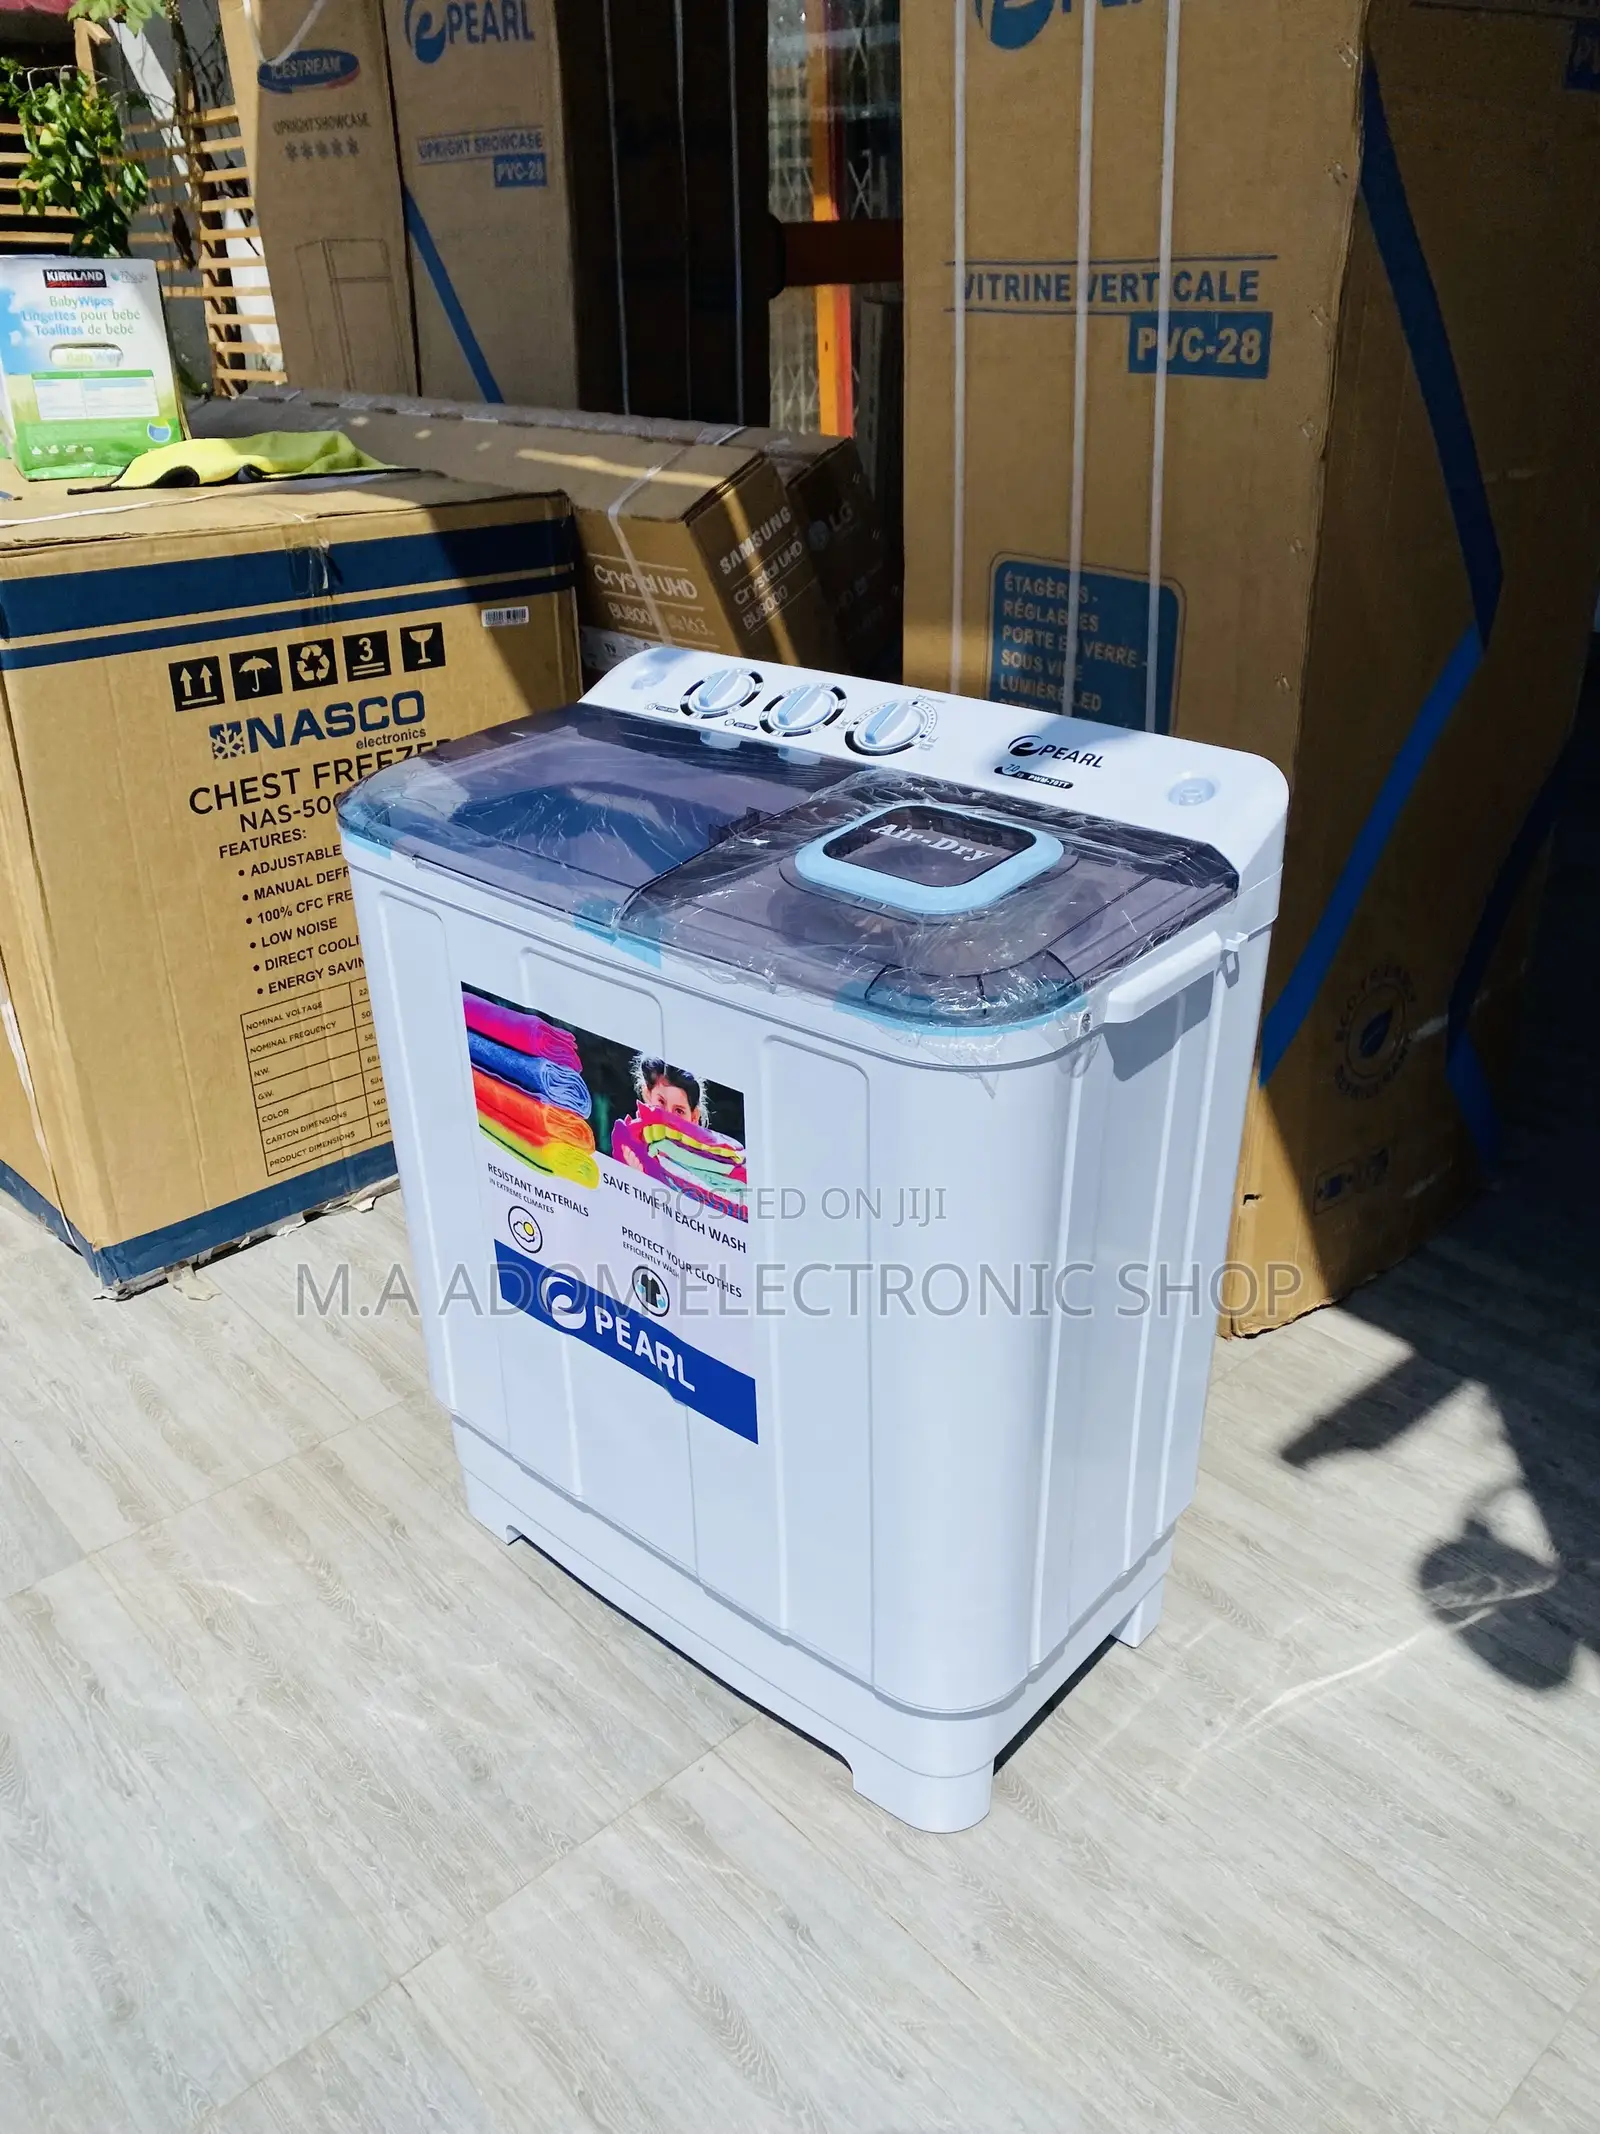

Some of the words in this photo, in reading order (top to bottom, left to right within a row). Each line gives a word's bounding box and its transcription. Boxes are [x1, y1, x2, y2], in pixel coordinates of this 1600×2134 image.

[447, 0, 535, 45] PEARL
[420, 137, 470, 159] UPRIGHT
[474, 131, 543, 154] SHOWCASE
[46, 270, 104, 282] KIRKLAND
[1088, 270, 1260, 303] VERTCALE
[22, 310, 77, 324] Lingettes
[81, 312, 108, 324] pour
[34, 324, 84, 336] Toallitas
[87, 324, 101, 335] de
[1136, 326, 1262, 365] PVC-28
[720, 506, 792, 575] SAMSUNG
[778, 540, 803, 568] UHD
[594, 564, 660, 594] Crysal
[657, 575, 698, 600] UHD
[1003, 569, 1089, 605] ÉTAGÈRS
[1003, 598, 1100, 634] RÉGLABES
[1002, 625, 1054, 650] PORTE
[1083, 641, 1137, 669] VERRE
[1000, 649, 1044, 674] SOUS
[1048, 660, 1083, 682] VIE
[1073, 691, 1102, 712] ED
[246, 689, 426, 754] NASCO
[356, 727, 427, 750] electronics
[1038, 744, 1104, 768] PEARL
[189, 768, 301, 815] CHEST
[313, 738, 452, 789] FREE
[219, 828, 307, 859] FEATURES:
[870, 823, 994, 862] Air-Dry
[251, 844, 343, 877] ADJUSTABLE
[254, 877, 313, 901] MANUAL
[257, 906, 293, 924] 100%
[296, 897, 324, 913] CFC
[261, 928, 293, 948] LOW
[296, 917, 338, 938] NOISE
[264, 947, 314, 972] DIRECT
[268, 968, 324, 995] ENERGY
[246, 1015, 284, 1031] NOMINAL
[285, 1001, 323, 1018] VOLTAGE
[249, 1038, 288, 1055] NOMINAL
[289, 1020, 337, 1042] FREQUENCY
[261, 1108, 290, 1123] COLOR
[265, 1128, 299, 1145] CARTON
[300, 1110, 349, 1133] DIMENSIONS
[269, 1148, 308, 1168] PRODUCT
[308, 1130, 356, 1153] DIMENSIONS
[487, 1162, 533, 1193] RESISTANT
[534, 1186, 589, 1217] MATERIALS
[496, 1181, 522, 1200] EXTREME
[523, 1195, 555, 1214] CLIMATES
[602, 1173, 630, 1195] SAVE
[632, 1186, 660, 1210] TIME
[662, 1202, 673, 1218] IN
[675, 1210, 706, 1235] EACH
[708, 1226, 747, 1253] WASH
[621, 1226, 665, 1255] PROTECT
[666, 1249, 692, 1274] YOUR
[695, 1268, 742, 1298] CLOTHES
[622, 1241, 661, 1266] EFFICIENTLY
[662, 1261, 680, 1278] WASH
[593, 1305, 696, 1393] PEARL
